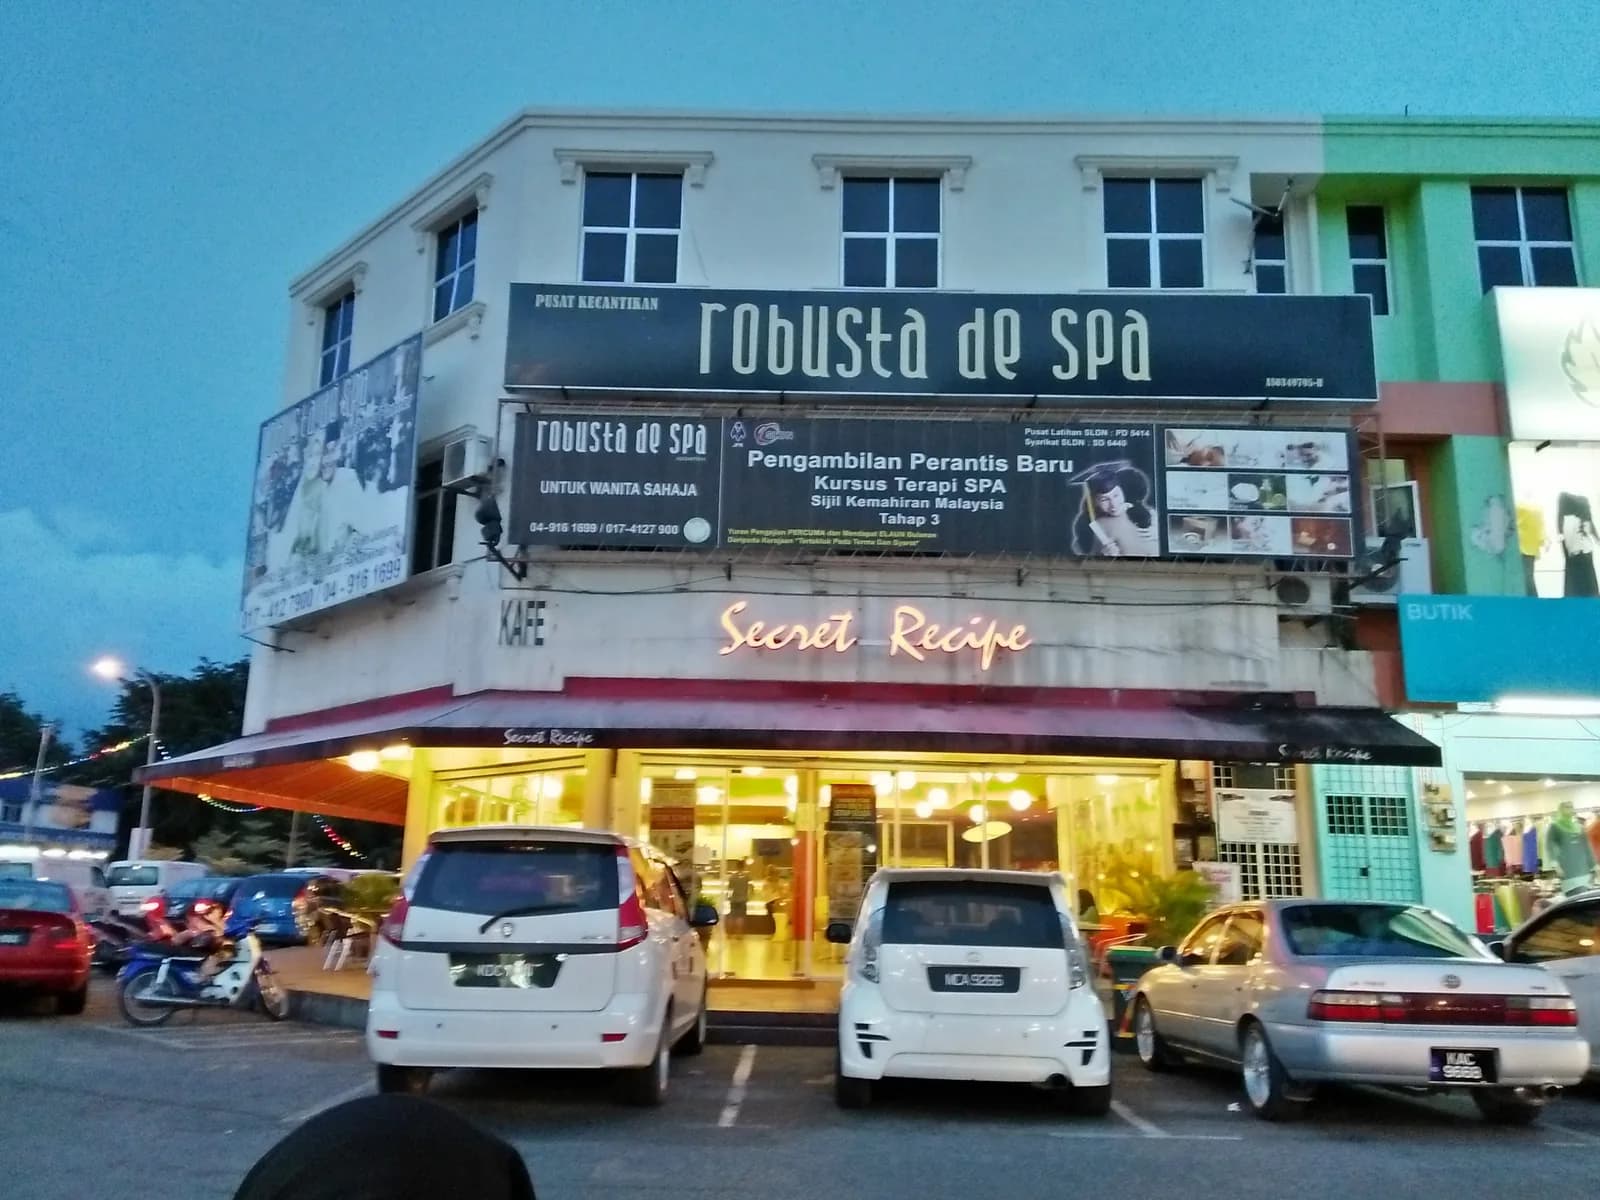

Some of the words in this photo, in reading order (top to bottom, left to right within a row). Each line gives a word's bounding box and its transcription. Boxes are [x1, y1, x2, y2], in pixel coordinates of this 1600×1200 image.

[535, 294, 575, 308] PUSAT
[578, 295, 658, 310] KECANTIKAN
[700, 302, 929, 379] robusta
[958, 307, 1021, 381] de
[1051, 307, 1152, 381] spa
[536, 420, 627, 453] robusta
[636, 422, 661, 455] de
[669, 422, 707, 456] spa
[1024, 428, 1049, 436] Pusat
[748, 450, 902, 473] Pengambilan
[910, 453, 1008, 472] Perantis
[1017, 455, 1074, 473] Baru
[540, 480, 587, 495] UNTUK
[590, 481, 640, 497] WANITA
[643, 482, 698, 497] SAHAJA
[814, 475, 888, 491] Kursus
[894, 477, 957, 496] Terapi
[964, 478, 1007, 494] SPA
[811, 495, 841, 509] Sijil
[846, 496, 929, 509] Kemahiran
[935, 498, 1004, 512] Malaysia
[529, 522, 568, 533] 04-916
[605, 523, 655, 535] 017-4127
[658, 524, 679, 535] 900
[879, 513, 926, 528] Tahap
[931, 514, 940, 526] 3
[1407, 603, 1473, 620] BUTIK
[498, 600, 545, 646] KAFE
[719, 601, 858, 655] Secret
[889, 605, 1033, 671] Recipe
[503, 728, 545, 745] Secret
[549, 729, 594, 748] Recipe
